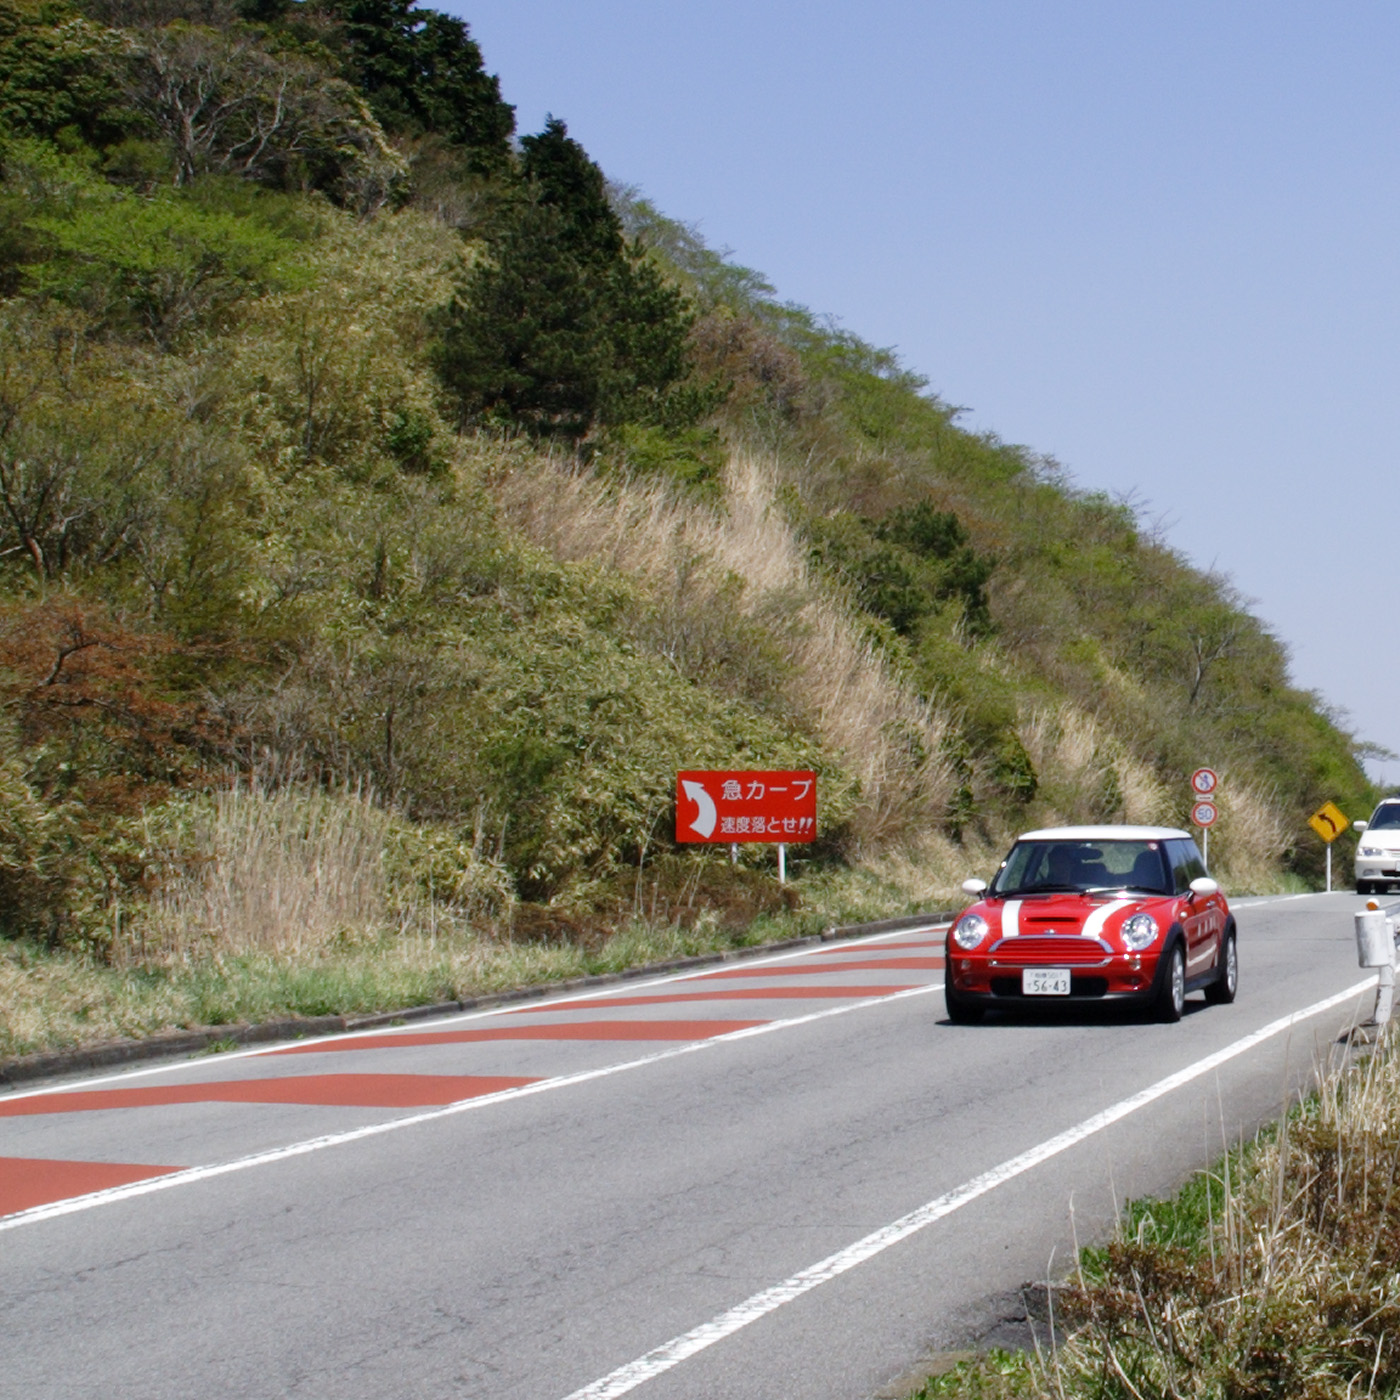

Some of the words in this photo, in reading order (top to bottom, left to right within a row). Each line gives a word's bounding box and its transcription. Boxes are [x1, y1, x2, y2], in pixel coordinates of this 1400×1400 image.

[721, 779, 813, 801] 急カーブ
[1197, 808, 1213, 820] 50
